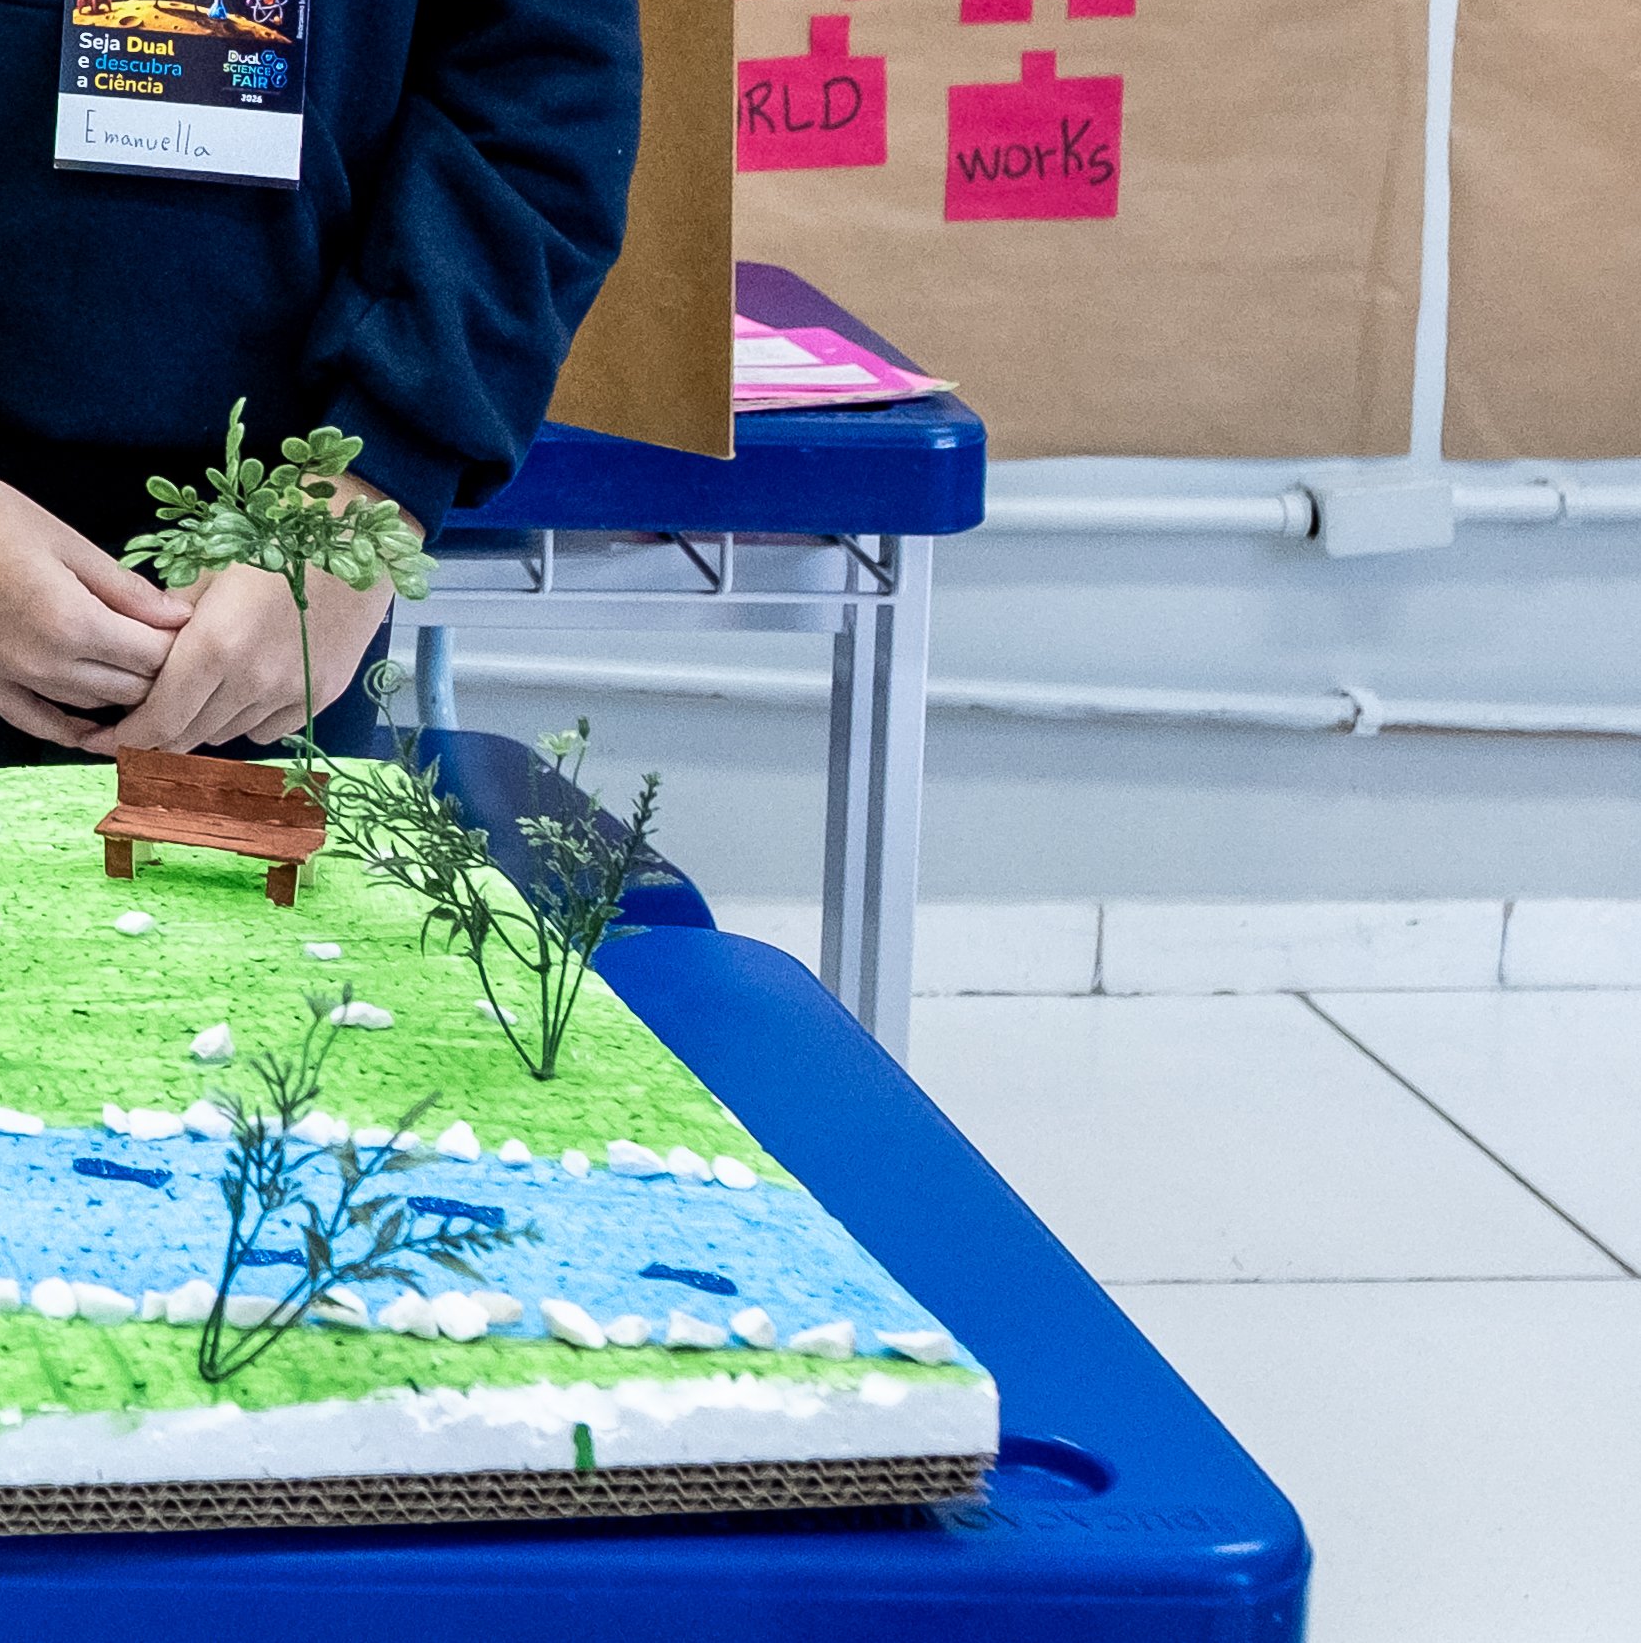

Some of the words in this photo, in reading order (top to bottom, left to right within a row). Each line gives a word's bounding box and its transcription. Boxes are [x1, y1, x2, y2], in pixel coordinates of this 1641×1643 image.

[79, 32, 121, 53] Seja
[127, 36, 175, 56] Dual
[77, 56, 89, 68] e
[95, 53, 183, 77] descubra
[228, 50, 261, 65] Dual
[223, 63, 271, 76] SCIENCE
[76, 76, 87, 88] a
[94, 72, 164, 94] Ciência
[232, 74, 268, 89] FAIR
[737, 76, 863, 134] RLD
[85, 109, 211, 157] Emanuella
